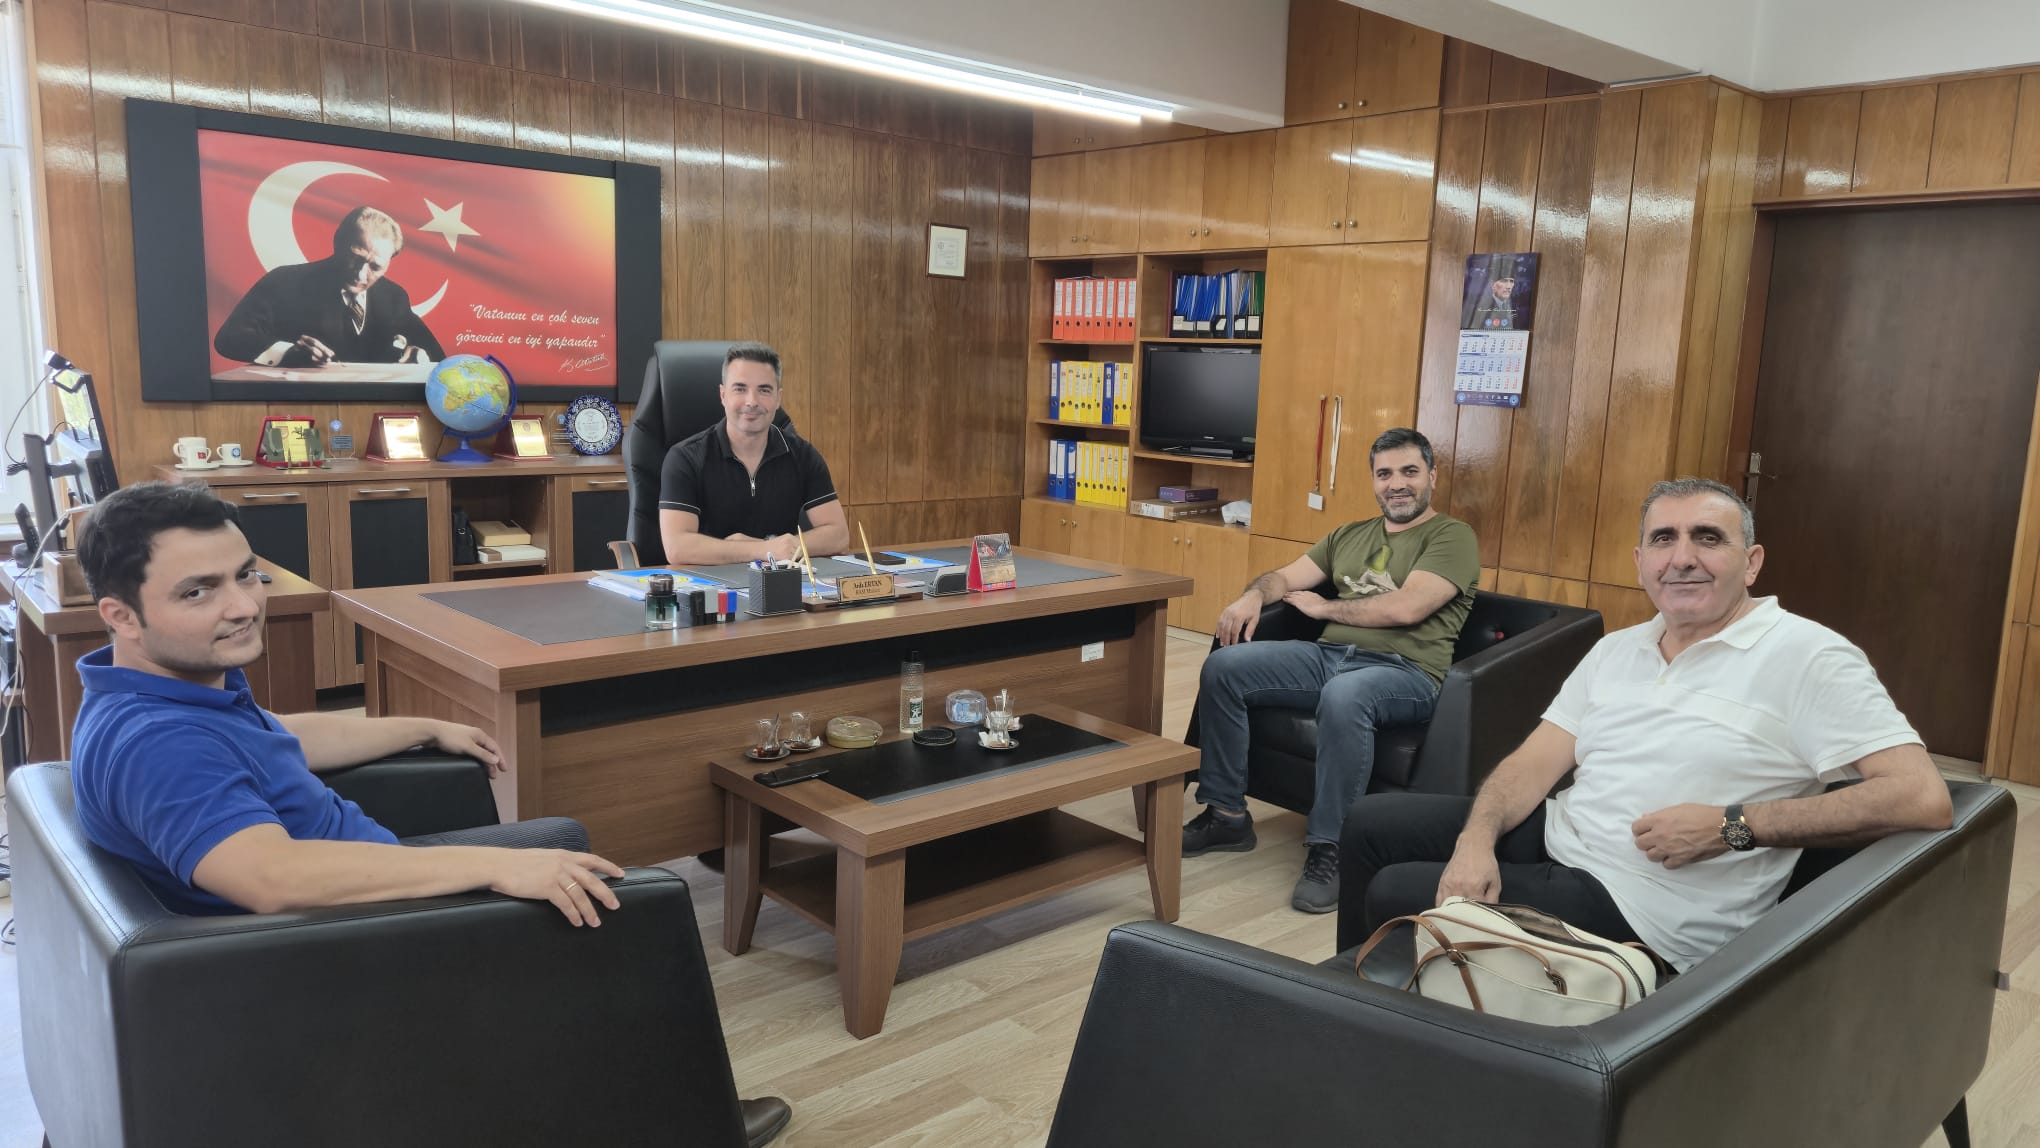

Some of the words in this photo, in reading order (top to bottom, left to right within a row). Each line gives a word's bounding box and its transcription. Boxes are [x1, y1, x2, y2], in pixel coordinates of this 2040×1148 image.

[531, 312, 545, 322] en
[549, 310, 568, 326] çok
[571, 316, 601, 325] seven
[455, 329, 505, 347] görevini
[508, 336, 522, 345] en
[525, 334, 542, 348] iyi
